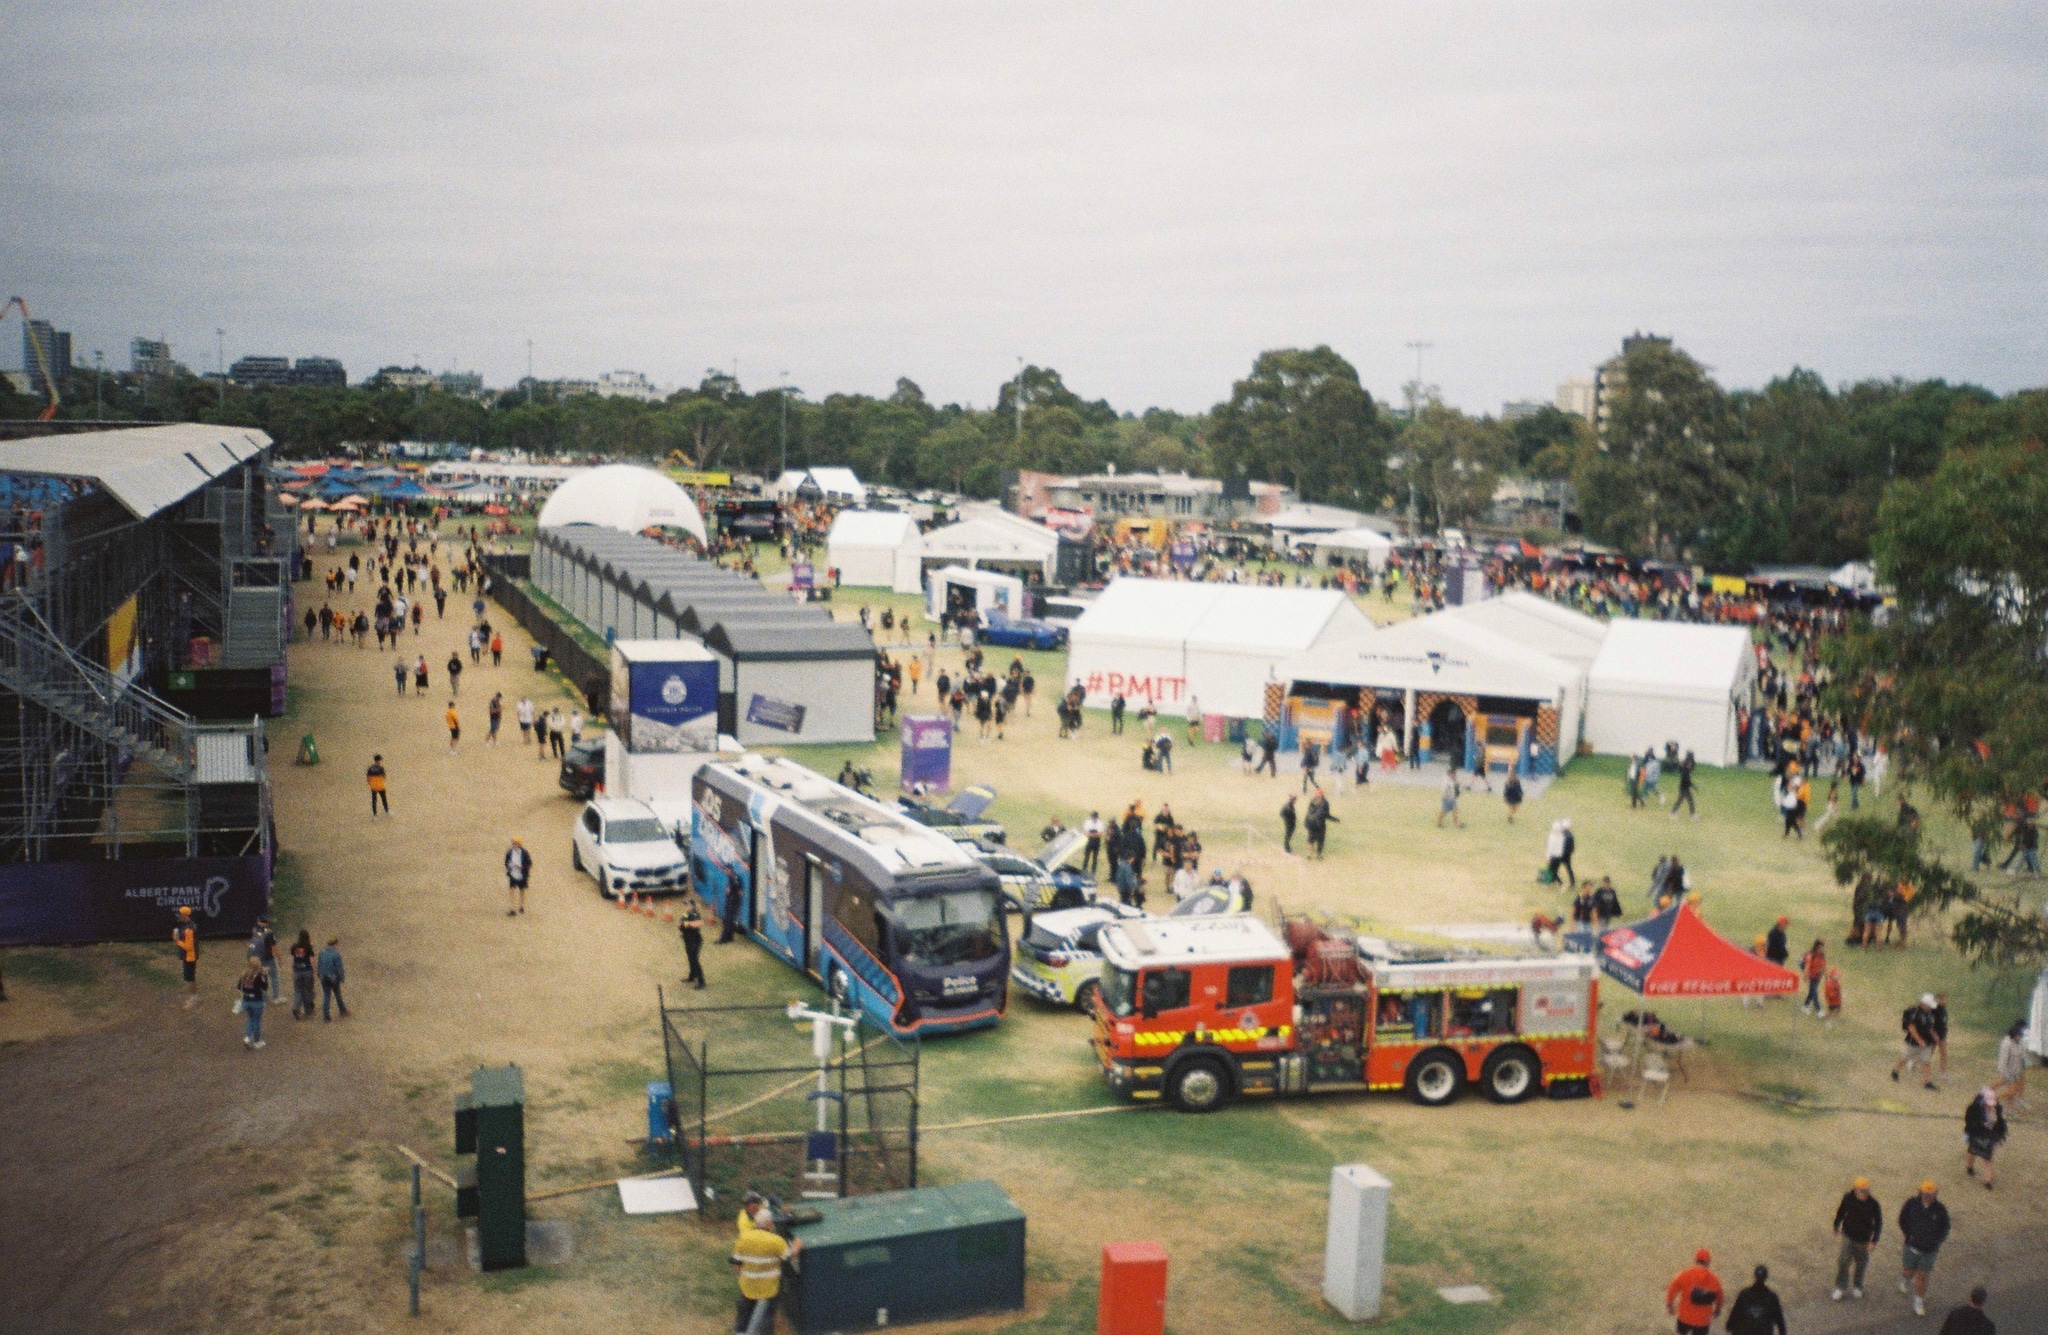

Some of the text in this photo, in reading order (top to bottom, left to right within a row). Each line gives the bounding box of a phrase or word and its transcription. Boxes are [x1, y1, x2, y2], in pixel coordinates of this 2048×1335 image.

[125, 886, 201, 898] ALBERT PARK
[157, 896, 201, 906] CIRCUIT
[1649, 977, 1794, 993] FIRE RESCUE VICTORIA
